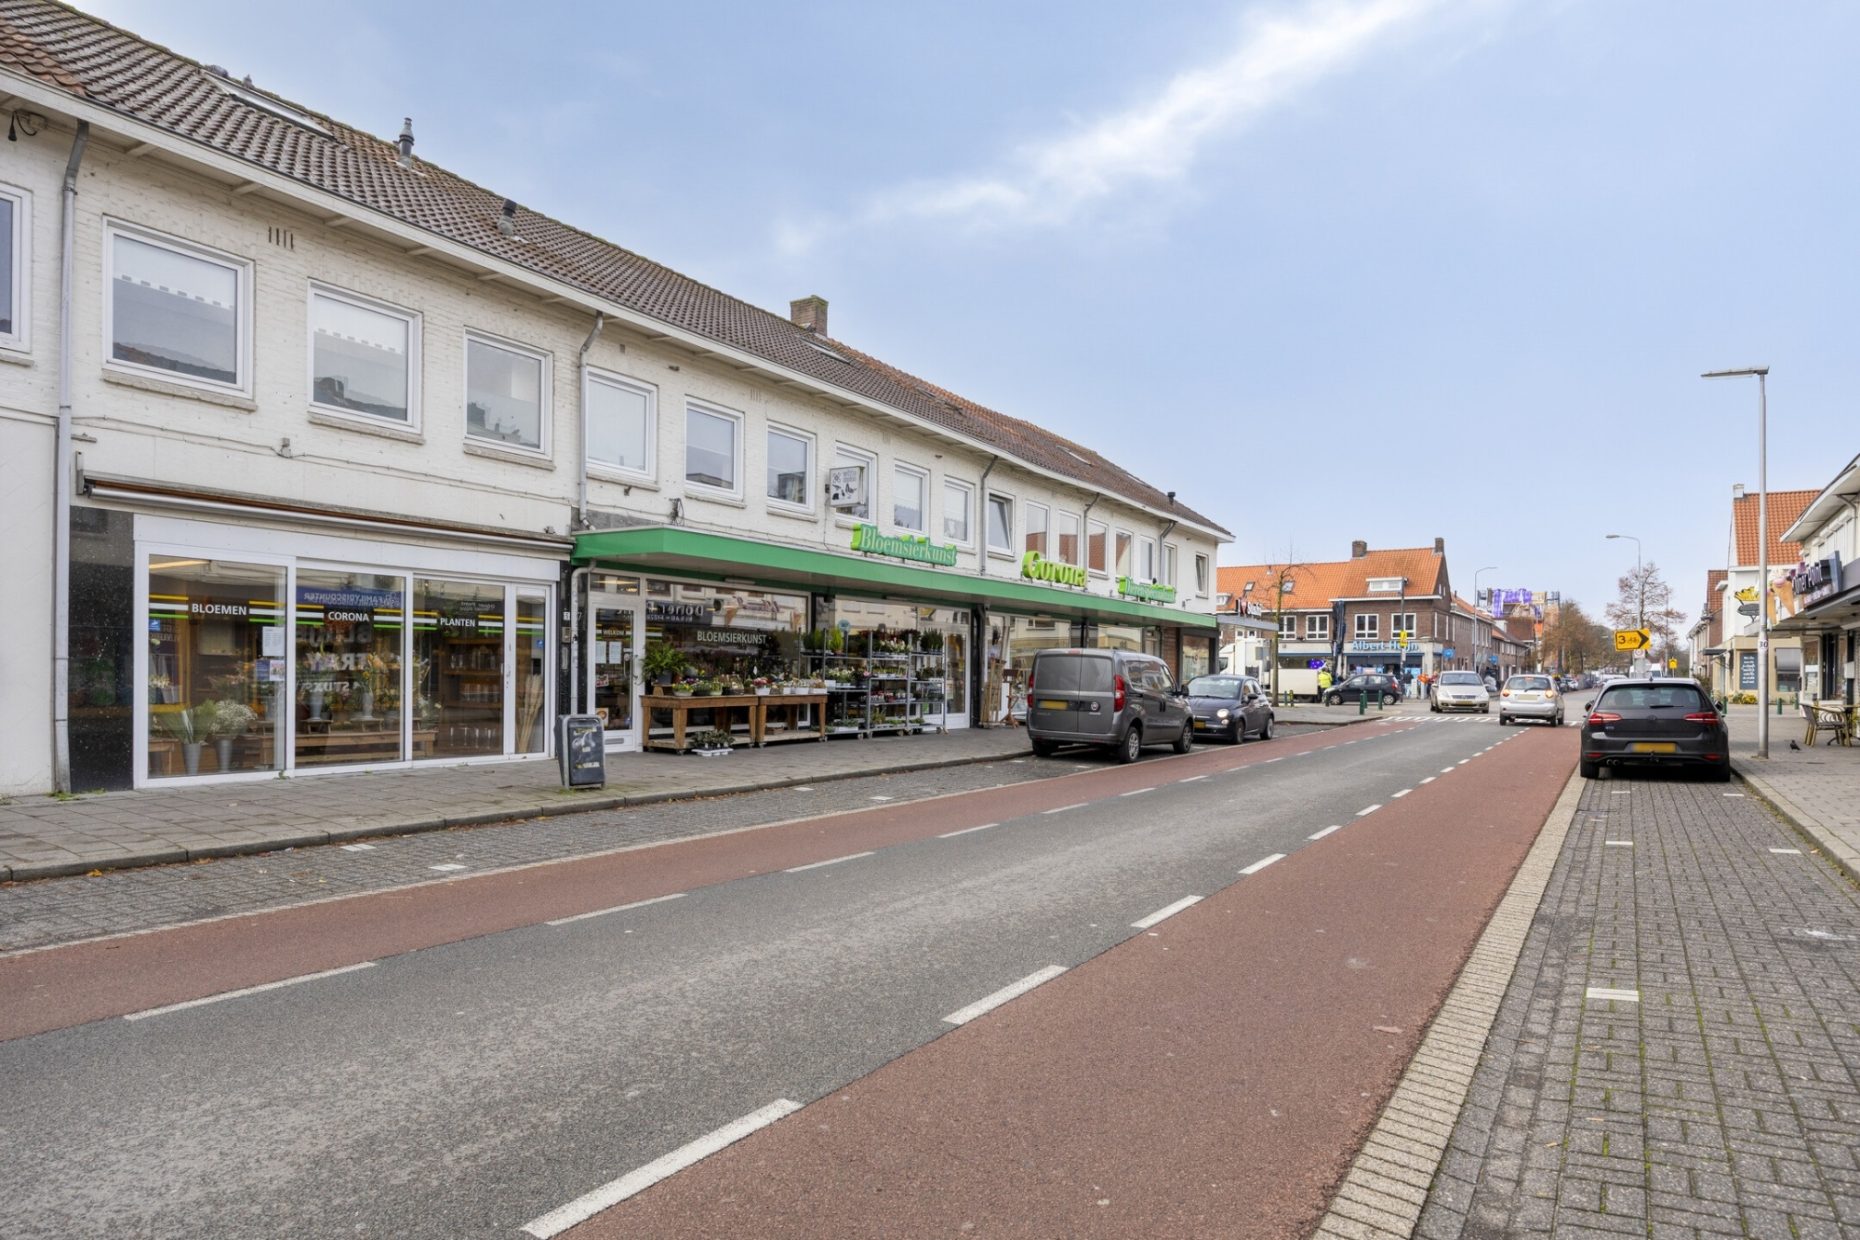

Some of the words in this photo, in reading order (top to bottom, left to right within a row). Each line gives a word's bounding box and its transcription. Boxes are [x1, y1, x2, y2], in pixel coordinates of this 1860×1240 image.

[860, 525, 956, 565] Bloemsierkunst
[1022, 550, 1087, 588] Corona
[191, 603, 248, 616] BLOEMEN
[328, 611, 370, 622] CORONA
[440, 617, 476, 627] PLANTEN
[696, 630, 767, 644] BLOEMSIERKUNST
[1617, 635, 1626, 644] 3
[1351, 640, 1384, 651] Albert
